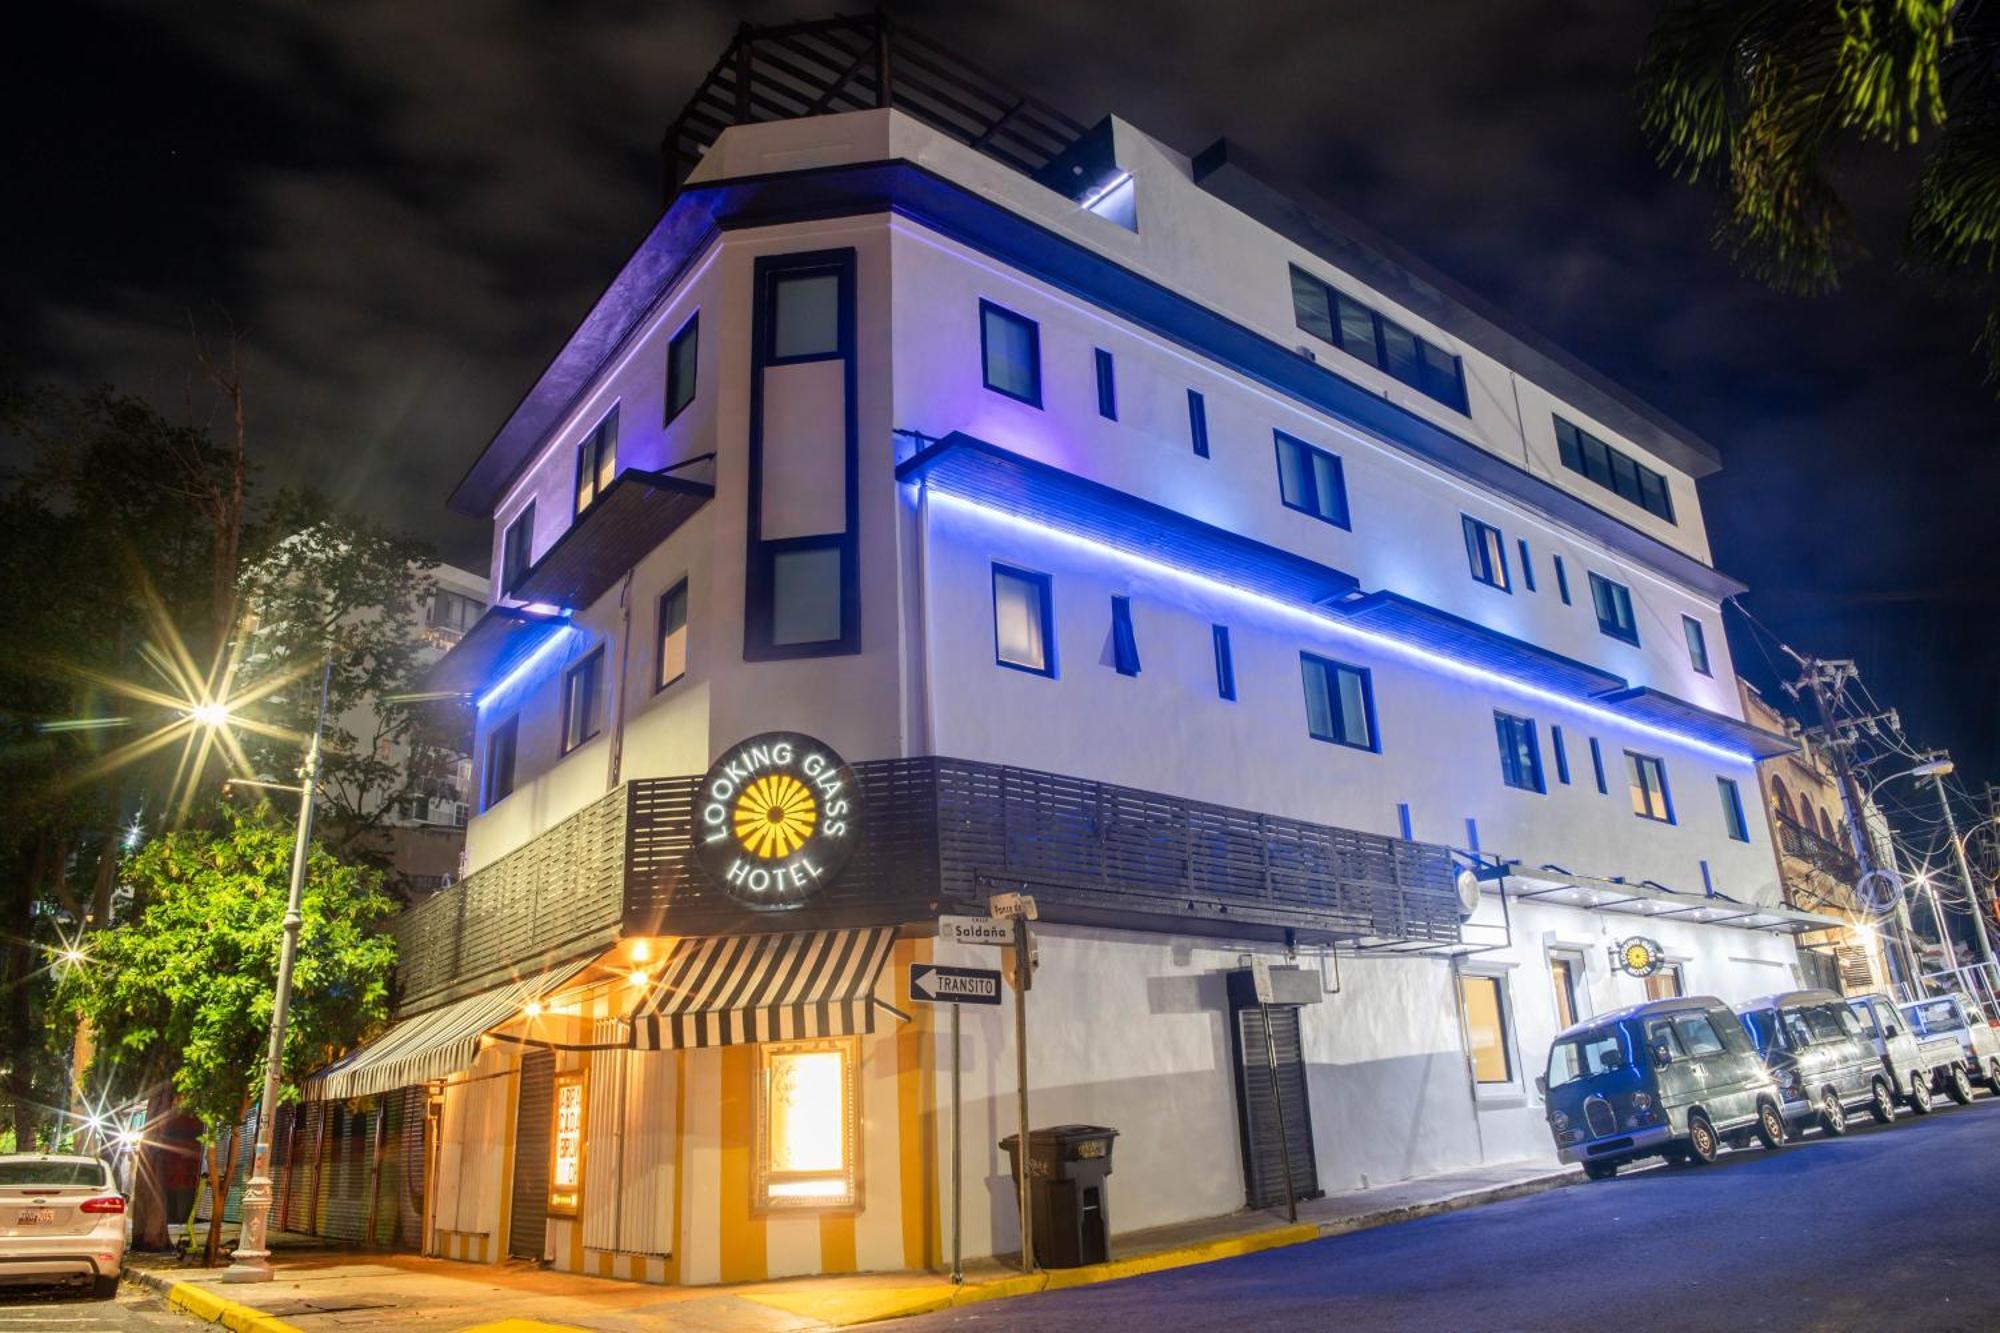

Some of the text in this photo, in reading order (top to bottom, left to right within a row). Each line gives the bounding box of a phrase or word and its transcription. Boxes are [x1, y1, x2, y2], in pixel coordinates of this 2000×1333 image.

[704, 743, 848, 843] LOOKING GLASS
[726, 860, 823, 892] HOTEL
[955, 926, 1006, 938] Saldaña
[938, 976, 993, 994] TRANSITO
